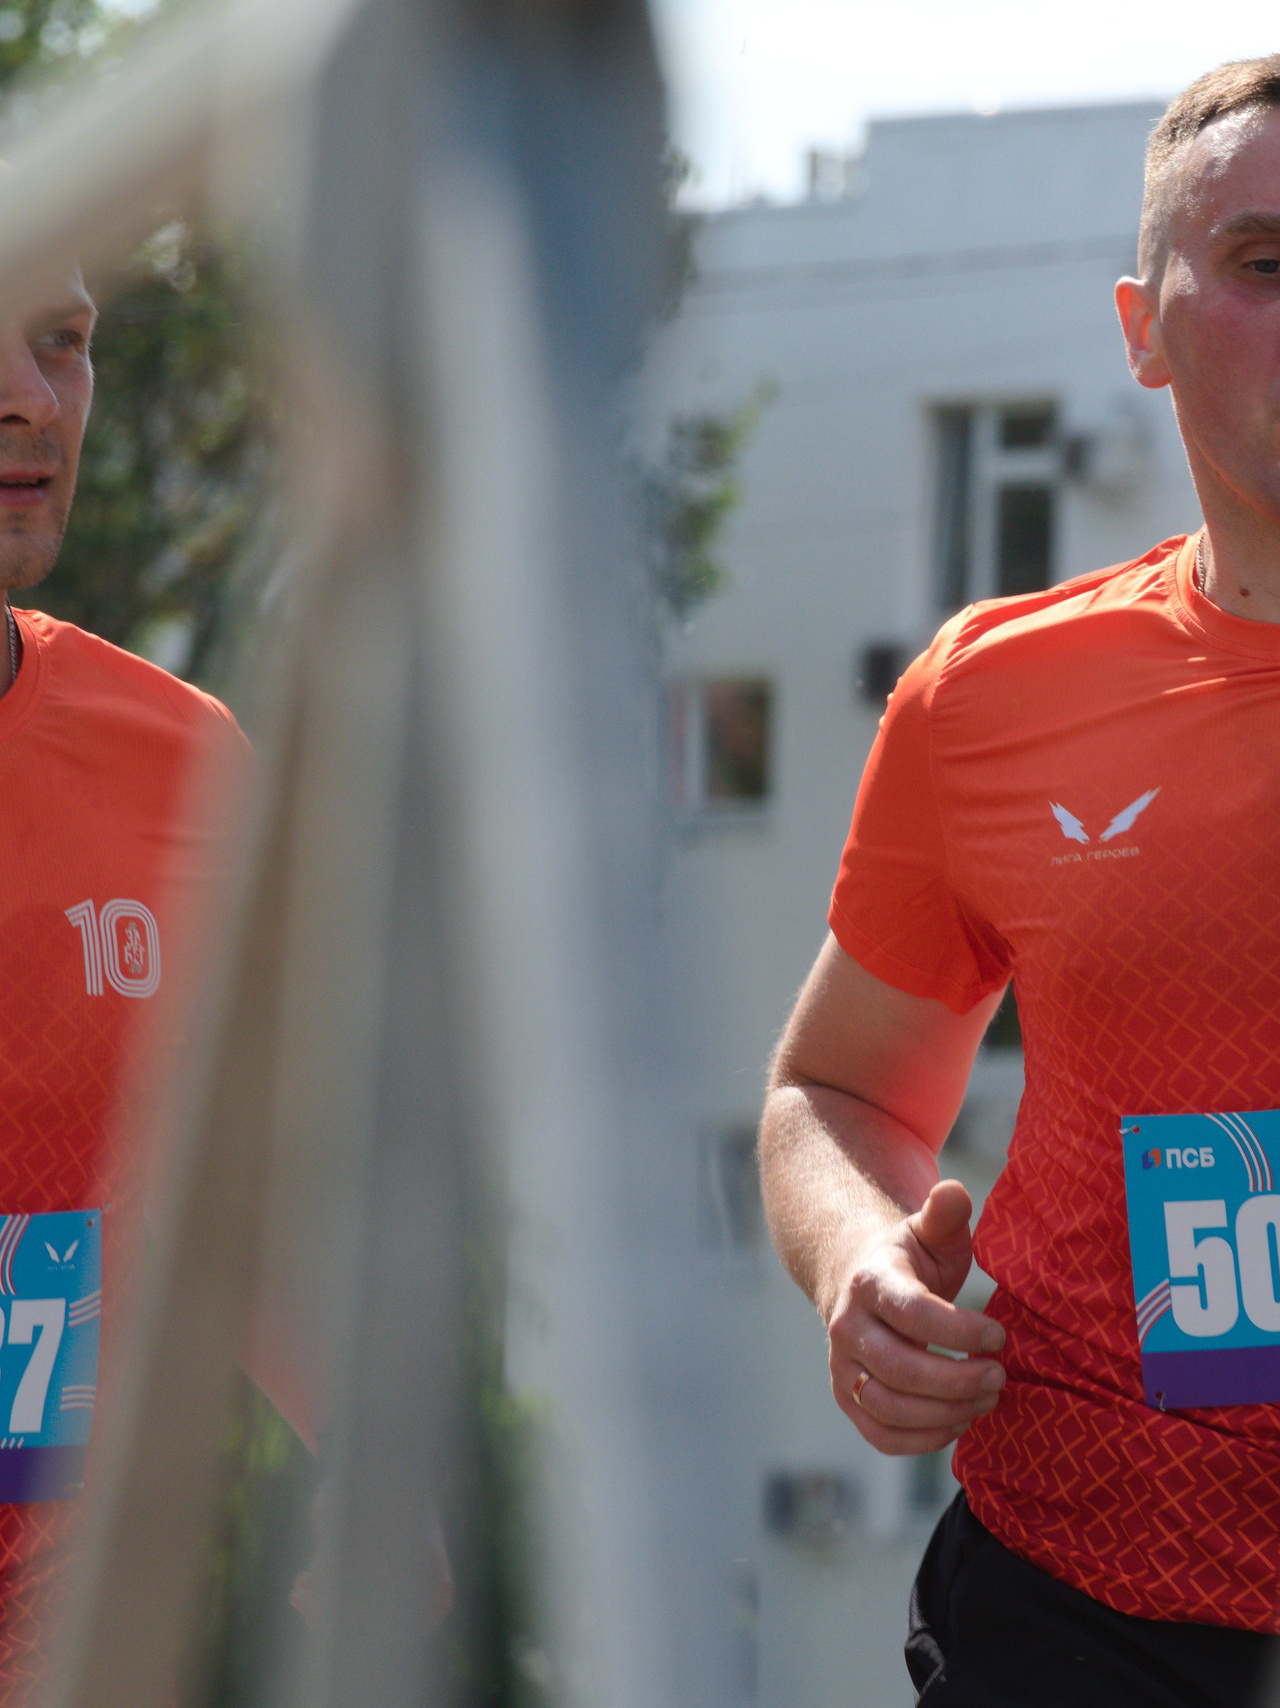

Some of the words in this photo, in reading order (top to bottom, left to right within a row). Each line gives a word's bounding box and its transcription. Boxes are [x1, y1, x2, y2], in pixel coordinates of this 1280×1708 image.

[1050, 853, 1082, 867] ЛИГА
[1086, 846, 1140, 861] ГЕРОЕВ
[63, 898, 161, 999] 10
[1165, 1146, 1216, 1169] ПСБ
[0, 1297, 66, 1434] 7
